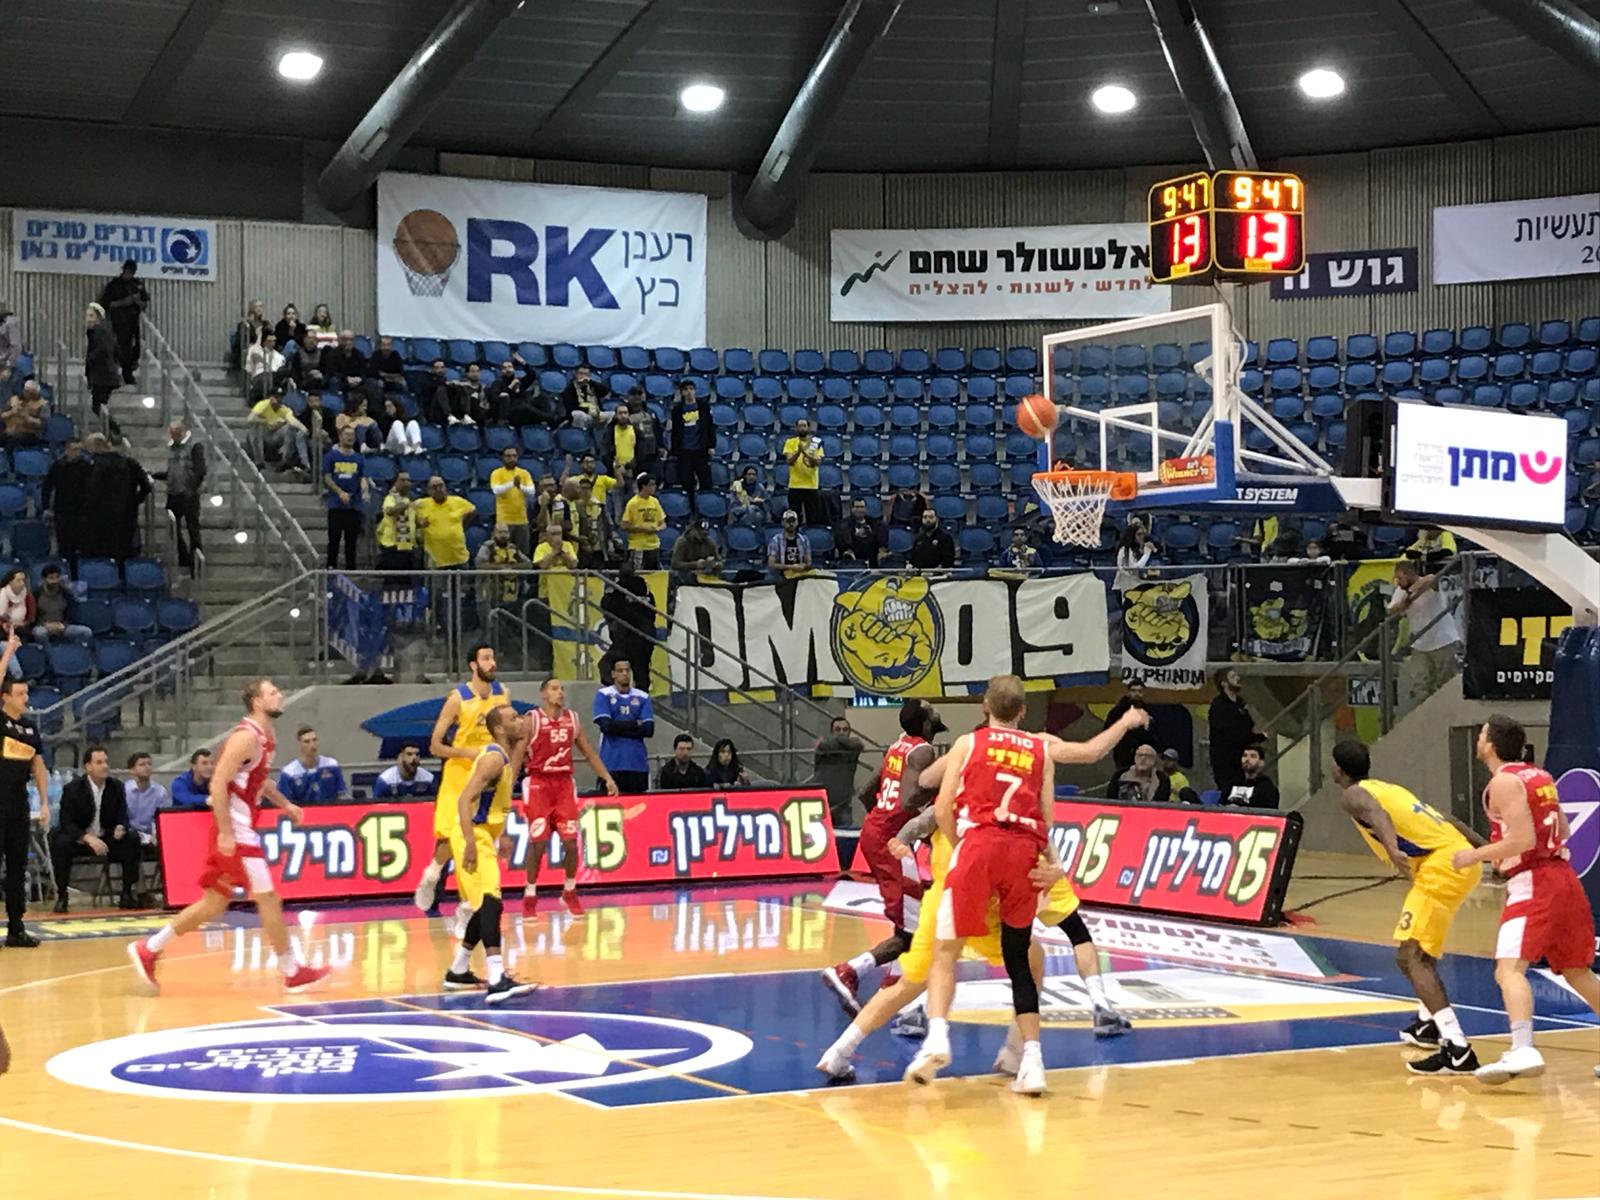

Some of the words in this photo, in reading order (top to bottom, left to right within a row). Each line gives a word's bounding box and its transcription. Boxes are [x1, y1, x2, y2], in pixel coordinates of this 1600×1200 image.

[1163, 178, 1209, 218] 9:47
[1234, 176, 1299, 209] 9:47
[26, 219, 87, 239] טובים
[94, 223, 156, 243] דברים
[1173, 216, 1200, 264] 13
[1247, 212, 1287, 262] 13
[21, 240, 58, 260] כאן
[65, 241, 156, 264] מתחילים
[467, 218, 621, 310] RK
[622, 231, 693, 268] רענן
[909, 250, 988, 274] שחם
[996, 239, 1150, 273] אלטשולר
[909, 279, 988, 295] להצליח
[1009, 277, 1075, 294] לשנות
[1328, 256, 1404, 288] גוש
[636, 277, 680, 315] כץ
[1448, 446, 1516, 486] מתן
[1244, 488, 1298, 501] SYSTEM
[1497, 671, 1554, 684] מקיימים
[550, 728, 568, 743] 55
[876, 777, 901, 810] 35
[995, 772, 1023, 820] 7
[264, 820, 355, 876] מילי
[359, 815, 409, 879] 15
[580, 808, 625, 869] 15
[672, 804, 781, 871] מיליון
[783, 801, 827, 860] 15
[1075, 817, 1120, 885] 15
[1134, 825, 1232, 898] מיליון
[1228, 830, 1278, 901] 15
[1079, 913, 1261, 949] אלטשול
